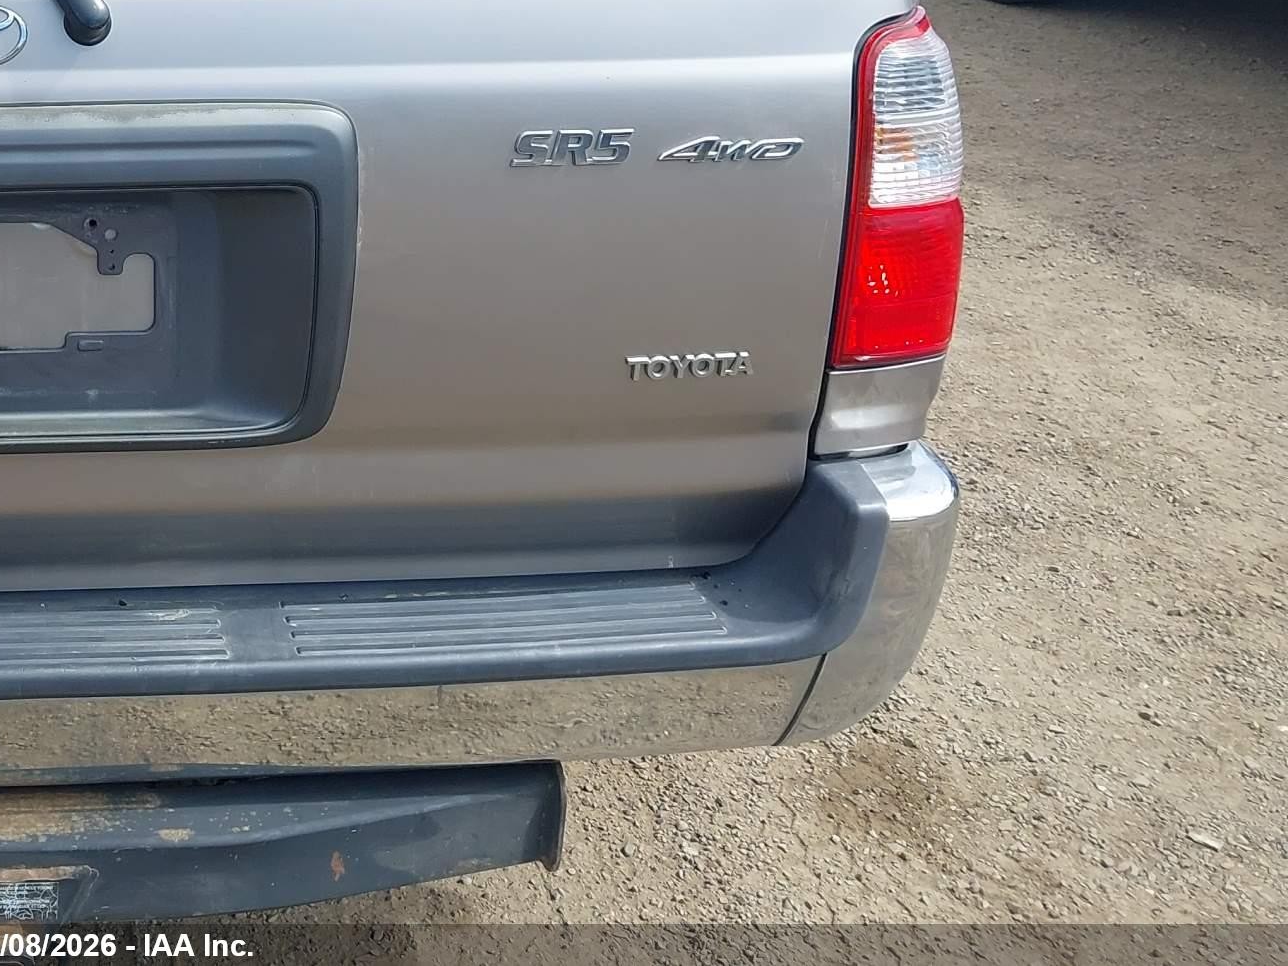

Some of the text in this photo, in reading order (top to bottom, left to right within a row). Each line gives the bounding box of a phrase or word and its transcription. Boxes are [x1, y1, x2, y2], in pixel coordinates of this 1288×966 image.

[510, 128, 804, 167] SR5 4WD
[625, 351, 753, 381] TOYOTA
